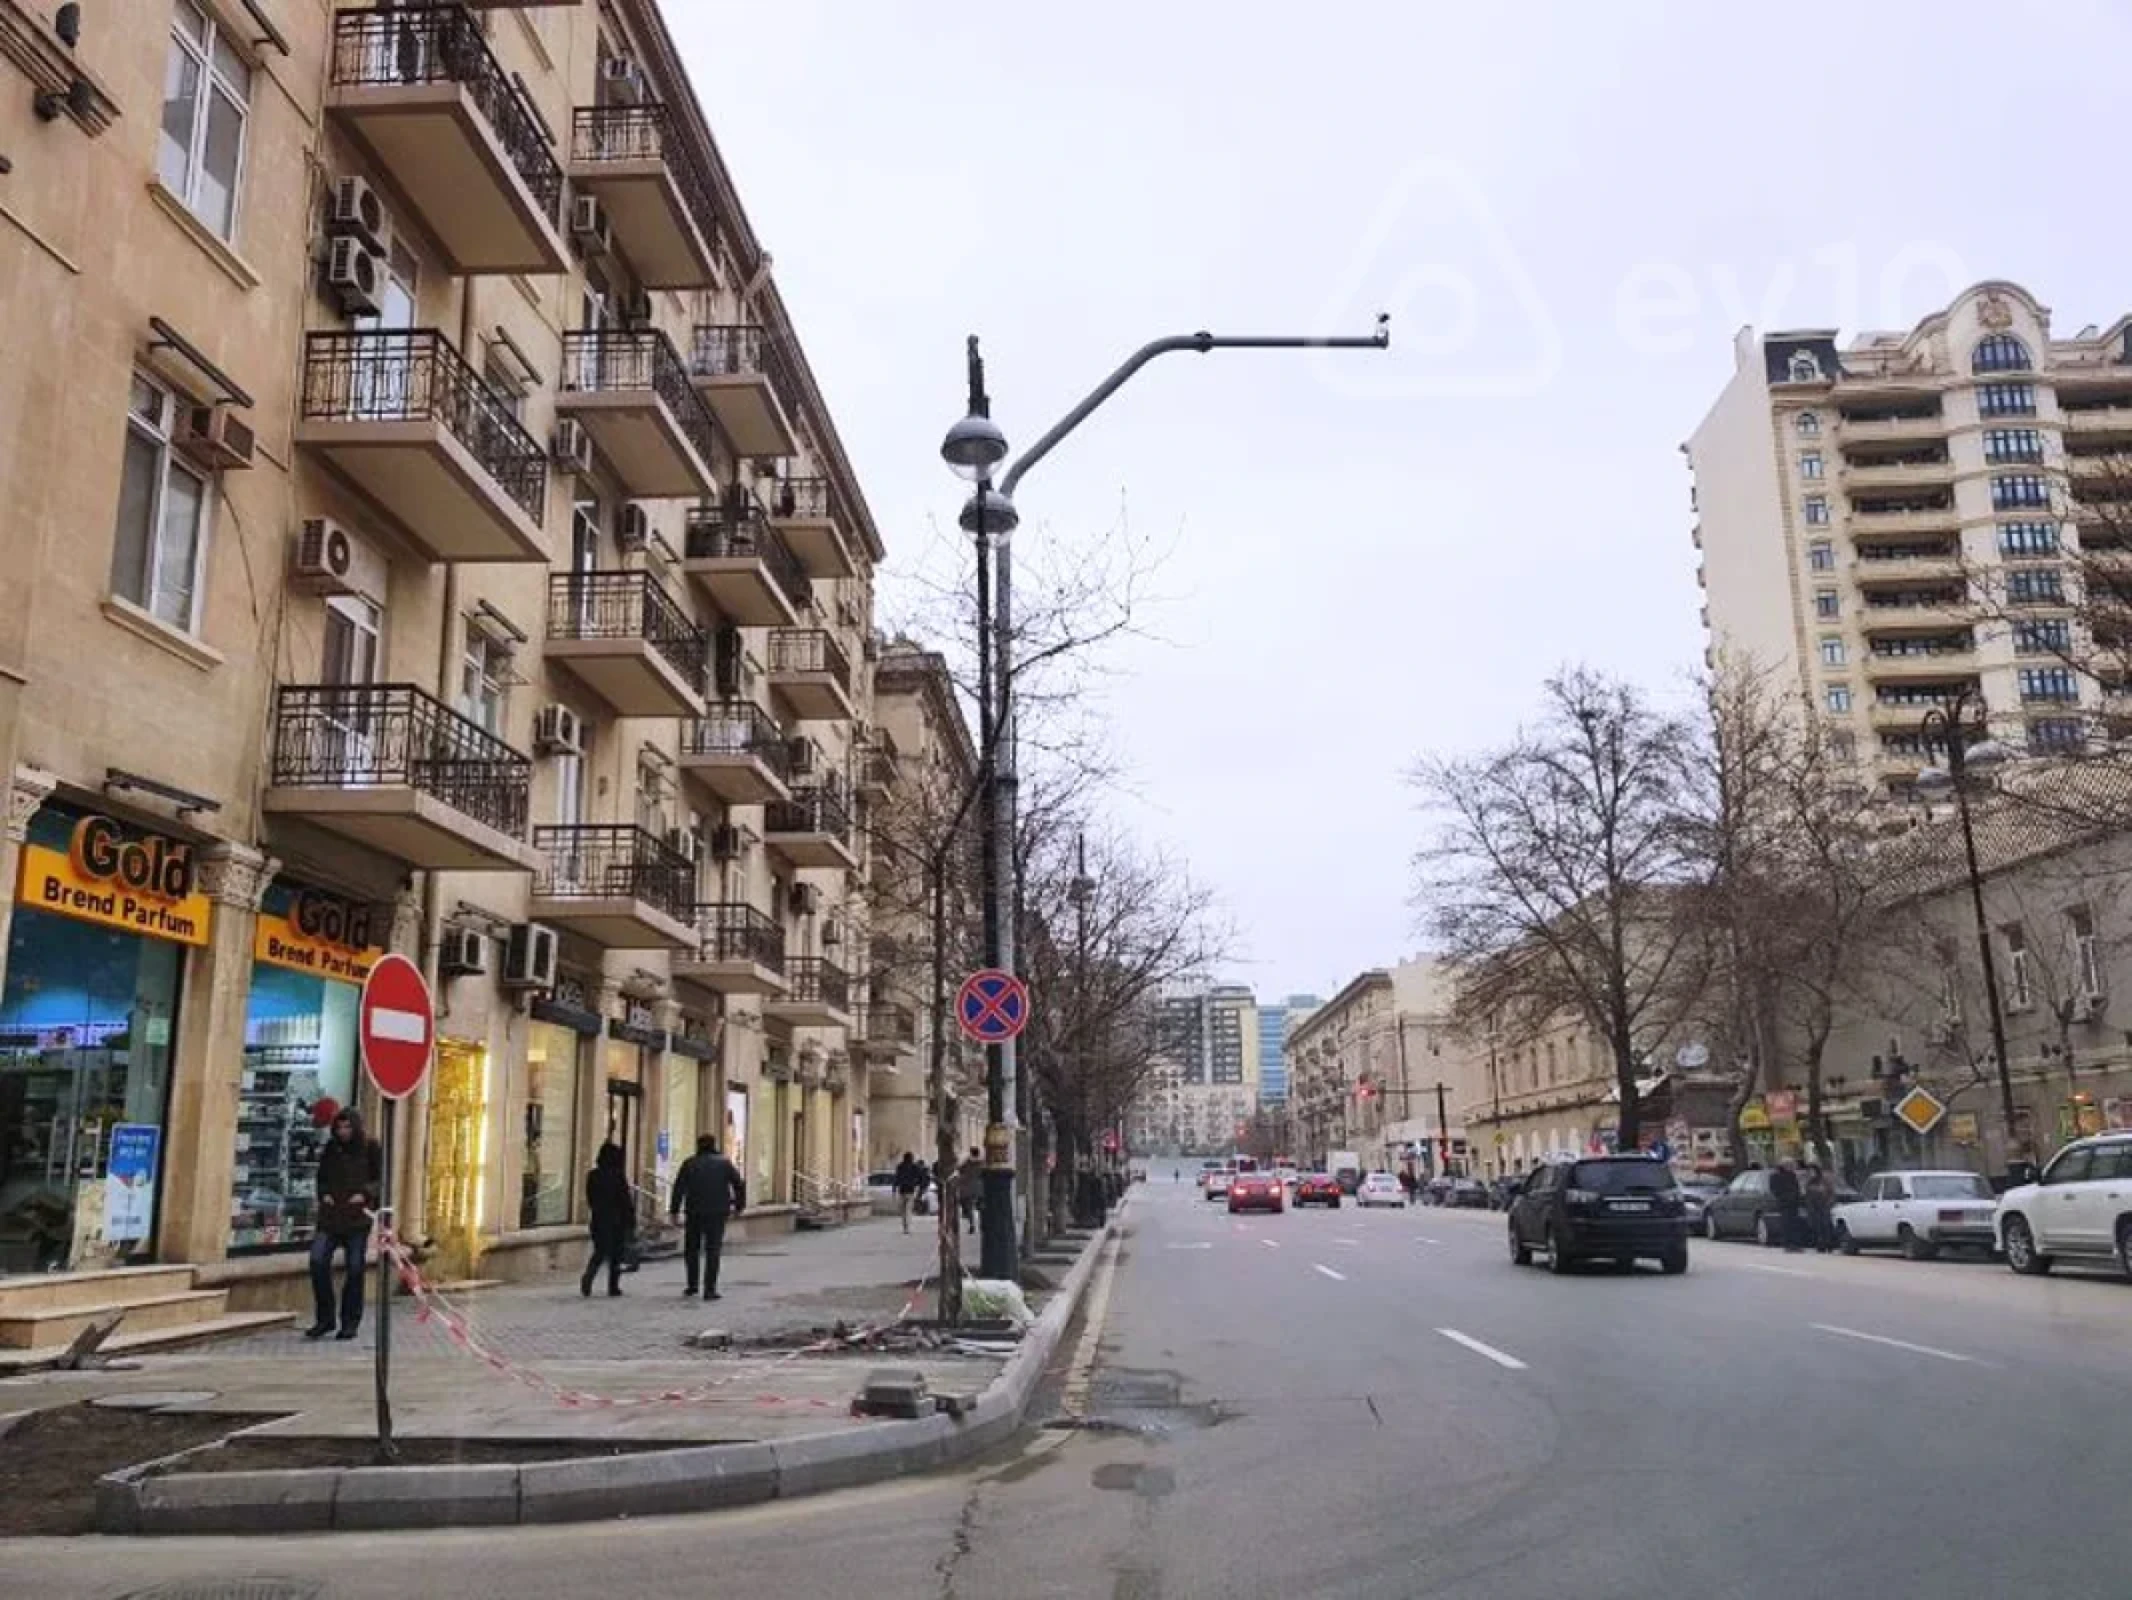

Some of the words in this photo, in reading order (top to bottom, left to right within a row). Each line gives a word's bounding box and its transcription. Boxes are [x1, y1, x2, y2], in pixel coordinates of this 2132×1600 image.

[74, 815, 195, 900] Gold
[43, 875, 115, 916] Brend
[122, 896, 195, 938] Parfum
[297, 890, 370, 951] Gold
[268, 936, 315, 967] Brend
